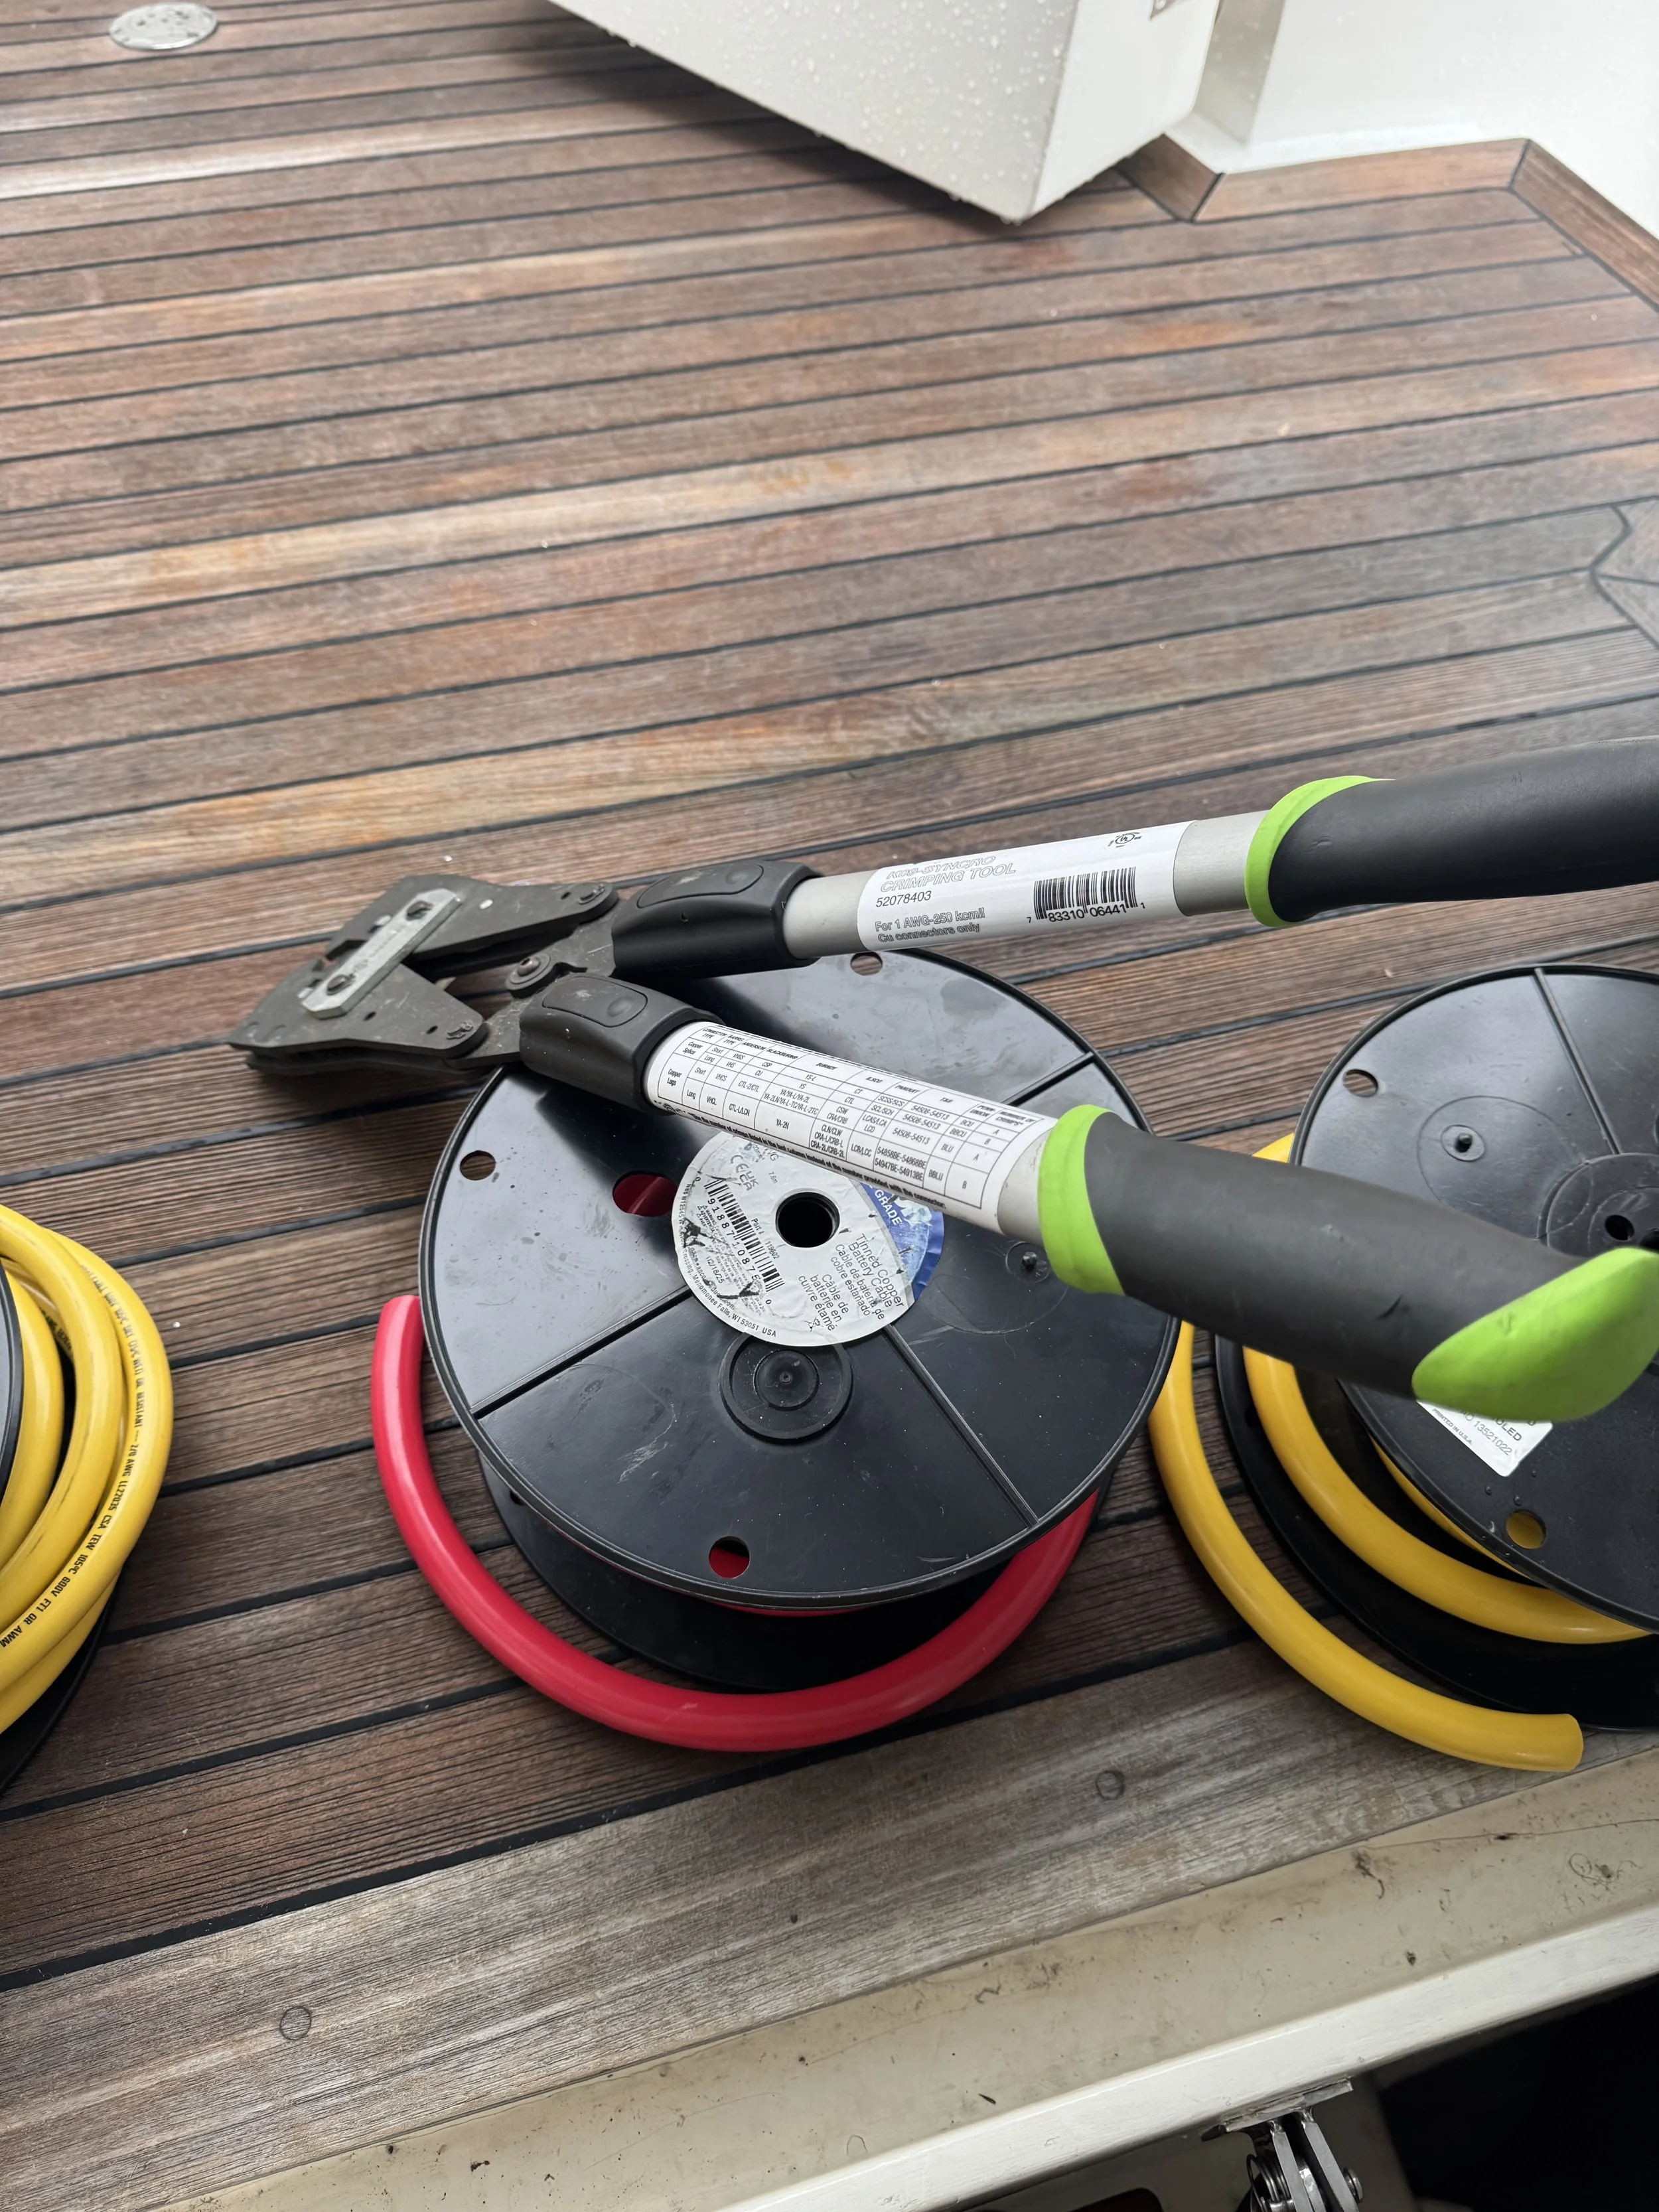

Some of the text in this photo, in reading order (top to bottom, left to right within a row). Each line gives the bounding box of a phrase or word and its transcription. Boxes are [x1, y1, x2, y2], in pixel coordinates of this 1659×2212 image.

[881, 863, 1016, 893] CRIMPING TOOL
[876, 891, 932, 907] 52078403
[875, 907, 985, 932] For 1 AWG-250 kcmil
[1048, 909, 1085, 922] 83310
[1090, 903, 1126, 917] 06441
[878, 922, 980, 942] Cu connectors only
[668, 1069, 682, 1078] Copper
[687, 1090, 696, 1100] Long
[707, 1096, 717, 1105] VHCL
[776, 1119, 790, 1130] YA-2N
[893, 1128, 930, 1145] 54508-54513
[941, 1143, 954, 1152] BLU
[928, 1169, 944, 1181] BBLU
[962, 1181, 967, 1189] B
[751, 1218, 762, 1231] Part
[849, 1242, 892, 1307] Battery Cable
[856, 1233, 904, 1307] Tinned Copper
[831, 1256, 871, 1316] cobre estañado
[836, 1244, 853, 1268] Cable
[850, 1268, 860, 1279] de
[874, 1308, 885, 1320] de
[798, 1276, 837, 1331] cuivre étamé
[810, 1274, 842, 1322] batterie en
[822, 1274, 849, 1313] Câble de
[692, 1274, 717, 1305] Menomonee
[717, 1303, 731, 1317] Falls,
[732, 1313, 741, 1322] WI
[741, 1318, 759, 1331] 53051
[762, 1327, 776, 1337] USA
[1431, 1408, 1453, 1428] PRINTED
[1474, 1420, 1512, 1455] 13521022
[123, 1459, 135, 1477] AWG
[109, 1481, 128, 1511] LL22035
[98, 1515, 112, 1529] CSA
[86, 1534, 102, 1550] TEW
[51, 1577, 70, 1597] 600V
[23, 1613, 37, 1625] OR
[0, 1625, 23, 1648] AWM
